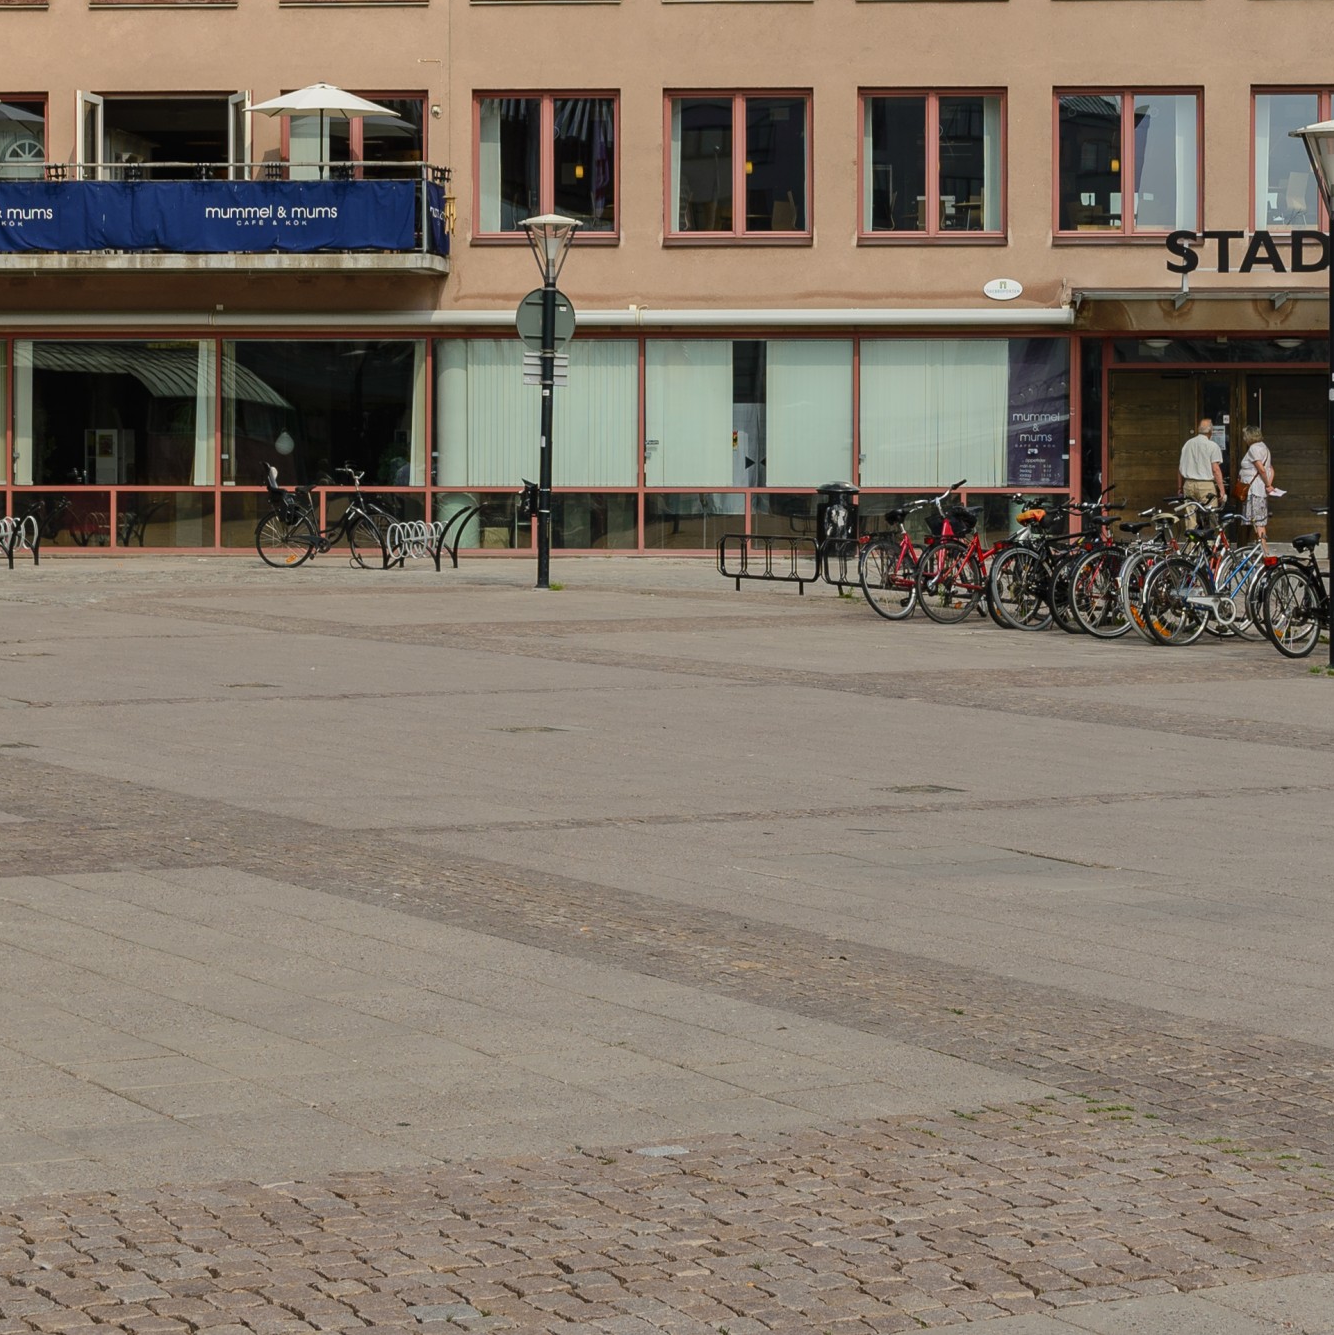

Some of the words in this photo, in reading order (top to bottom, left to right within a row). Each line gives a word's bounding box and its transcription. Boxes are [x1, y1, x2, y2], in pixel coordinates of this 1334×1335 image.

[6, 207, 53, 220] mums
[205, 204, 273, 219] mummel
[277, 206, 287, 219] &
[291, 206, 338, 219] mums
[1012, 412, 1060, 422] mummel
[1032, 423, 1040, 432] &
[1019, 433, 1053, 442] mums
